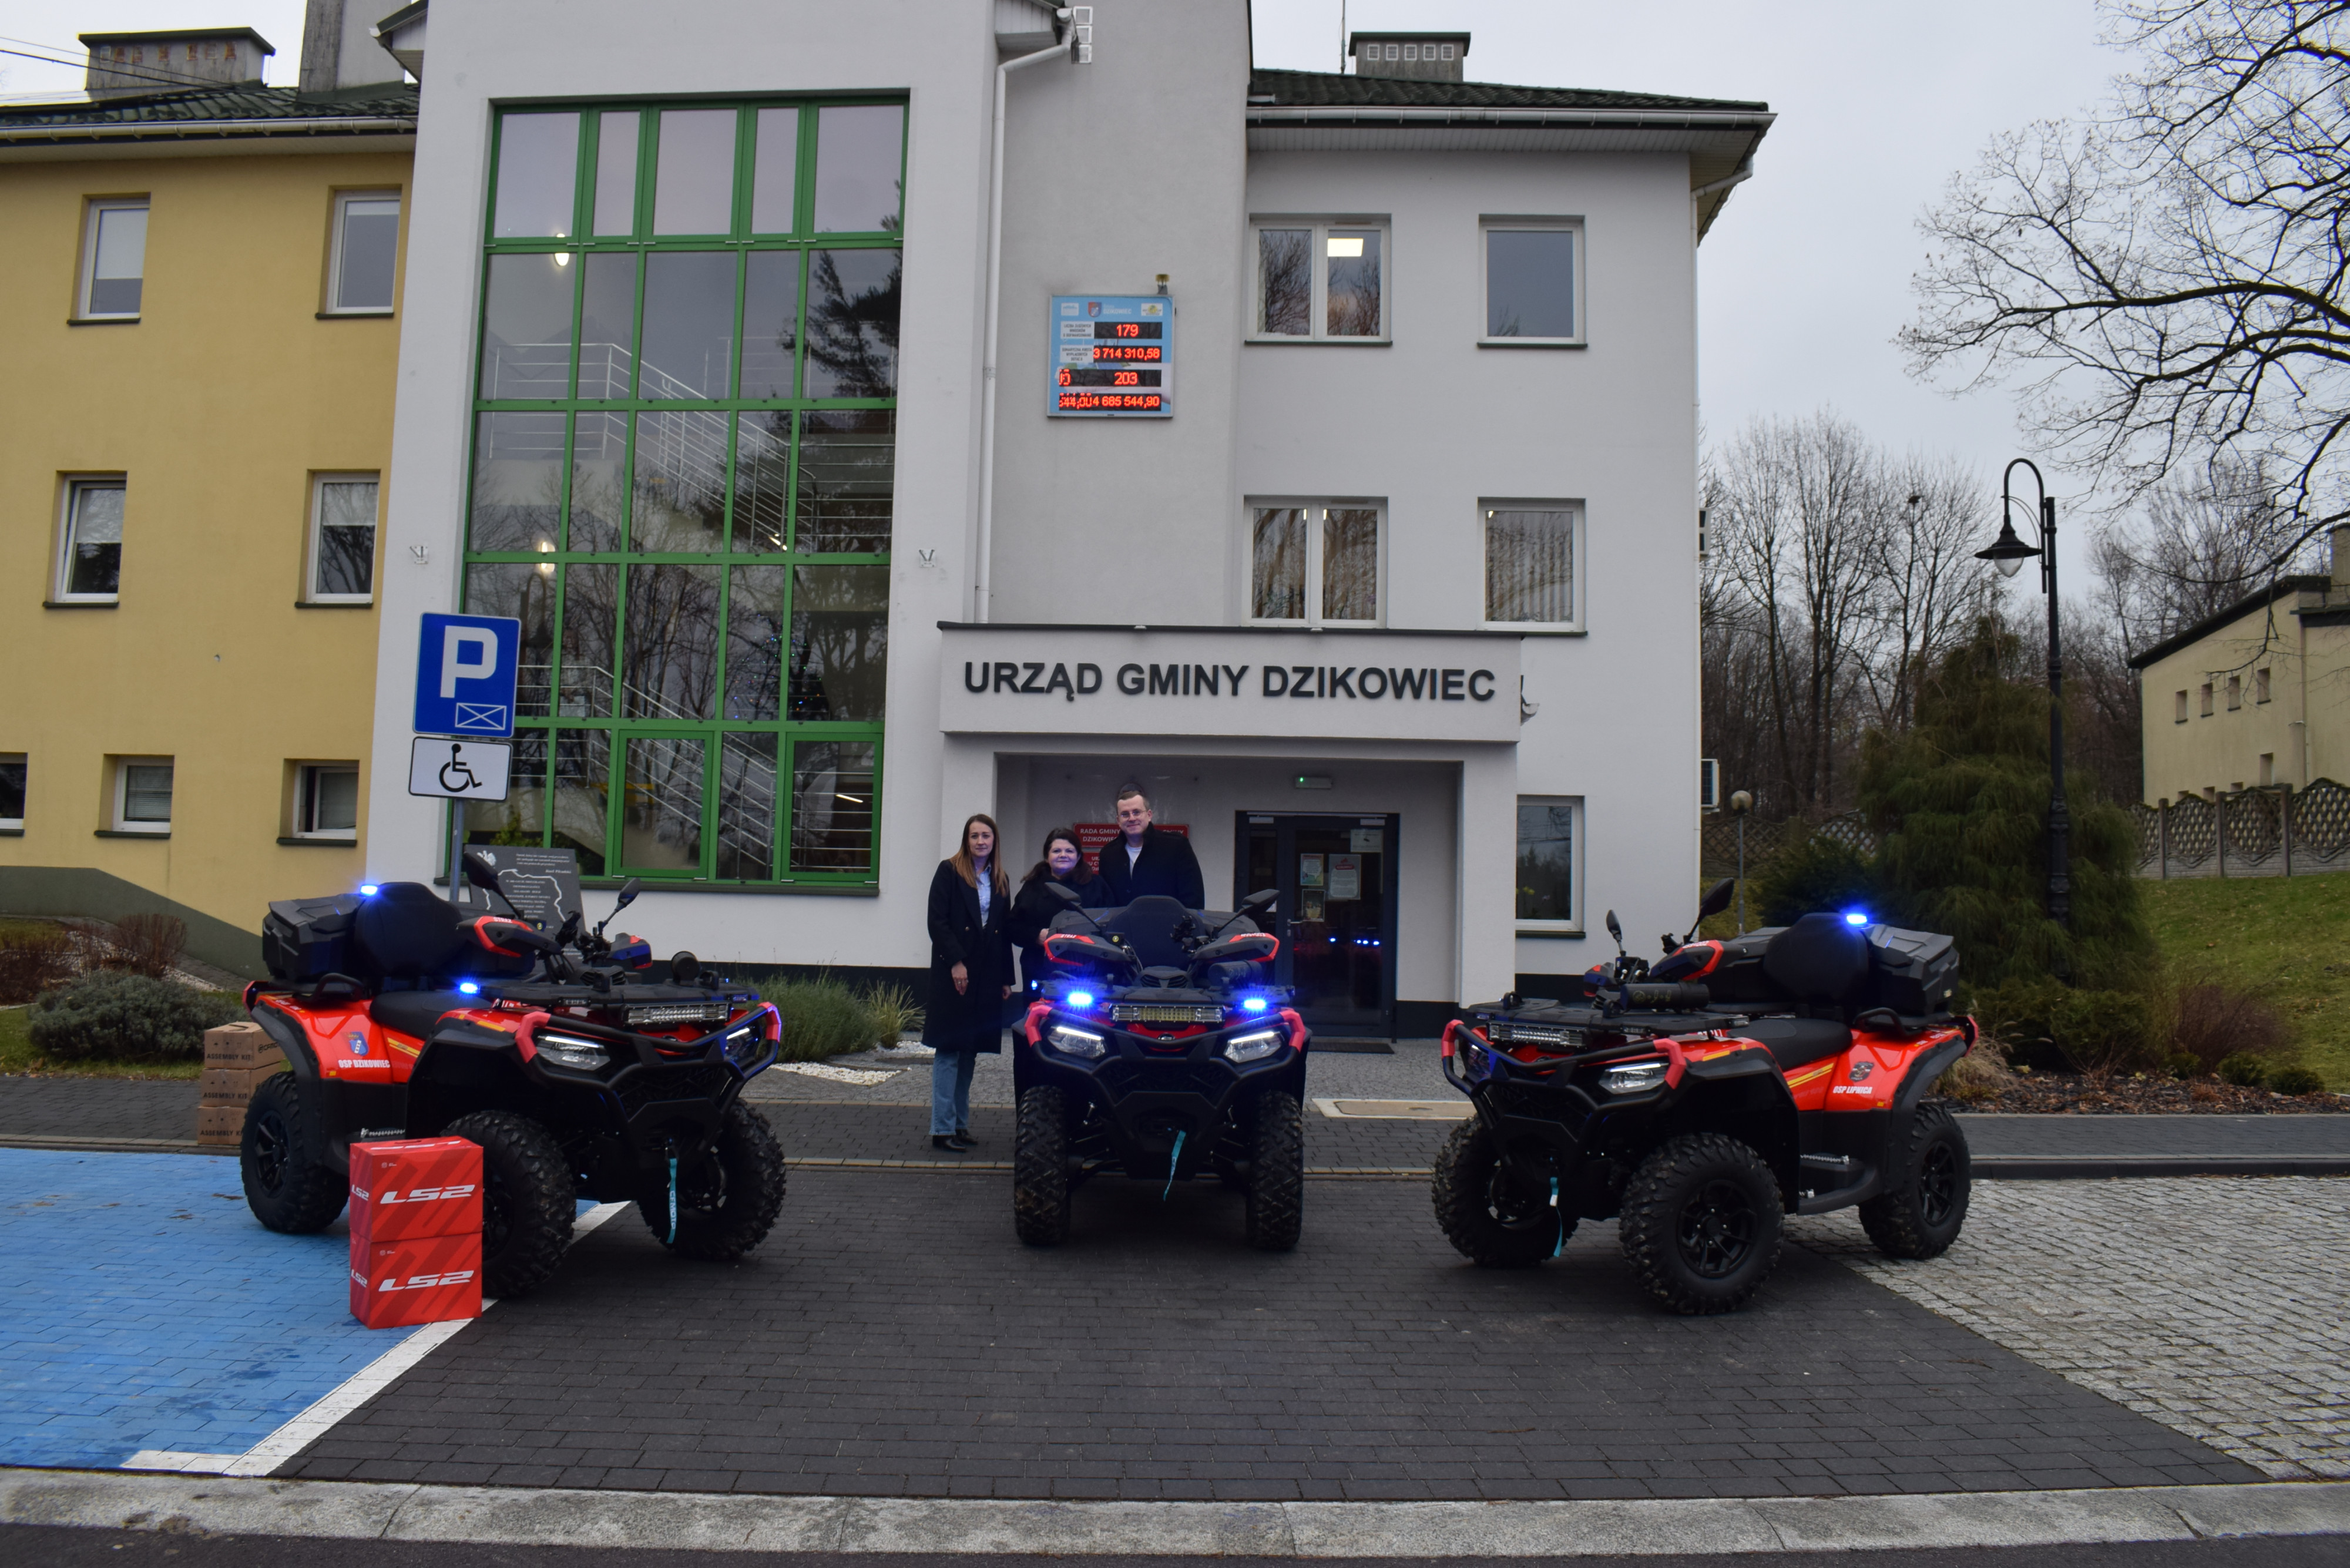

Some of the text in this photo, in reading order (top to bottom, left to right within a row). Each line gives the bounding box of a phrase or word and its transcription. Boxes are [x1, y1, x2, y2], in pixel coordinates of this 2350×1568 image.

[1117, 324, 1139, 337] 179
[1093, 348, 1160, 361] 3 714 310,58
[1114, 372, 1138, 385] 203
[1102, 396, 1122, 407] 685
[1124, 396, 1160, 408] 544,90
[440, 625, 498, 698] P
[965, 662, 1495, 701] URZĄD GMINY DZIKOWIEC
[338, 1060, 352, 1068] OSP
[352, 1060, 391, 1068] DZIKOWIEC
[352, 1184, 370, 1201] LS2
[380, 1184, 475, 1204] LS2
[351, 1269, 368, 1288] LS2
[378, 1270, 474, 1292] LS2
